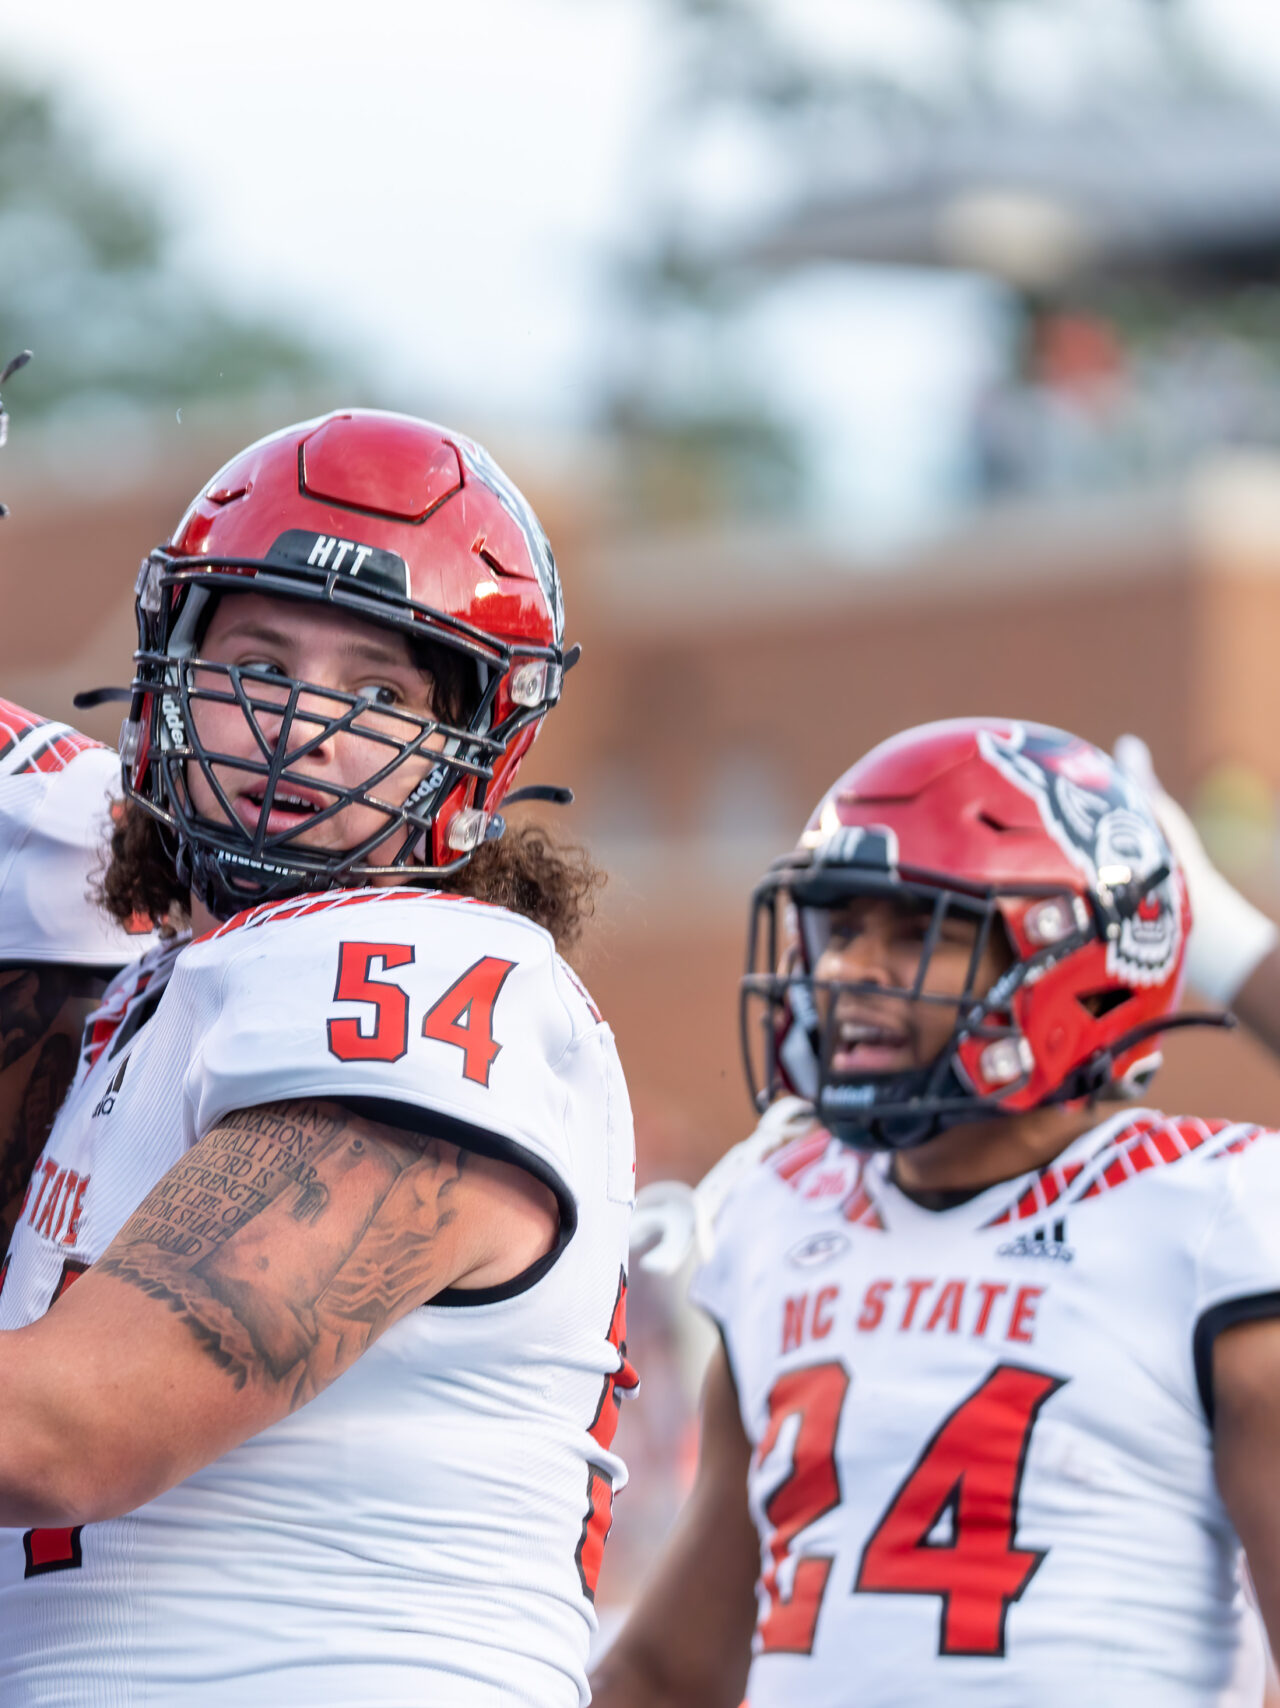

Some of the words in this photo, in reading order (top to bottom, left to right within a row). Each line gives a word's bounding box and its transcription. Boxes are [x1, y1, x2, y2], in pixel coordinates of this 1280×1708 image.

[306, 534, 373, 577] HTT
[326, 941, 520, 1089] 54
[780, 1285, 839, 1355] NC
[856, 1278, 1047, 1345] STATE
[756, 1360, 1072, 1660] 24
